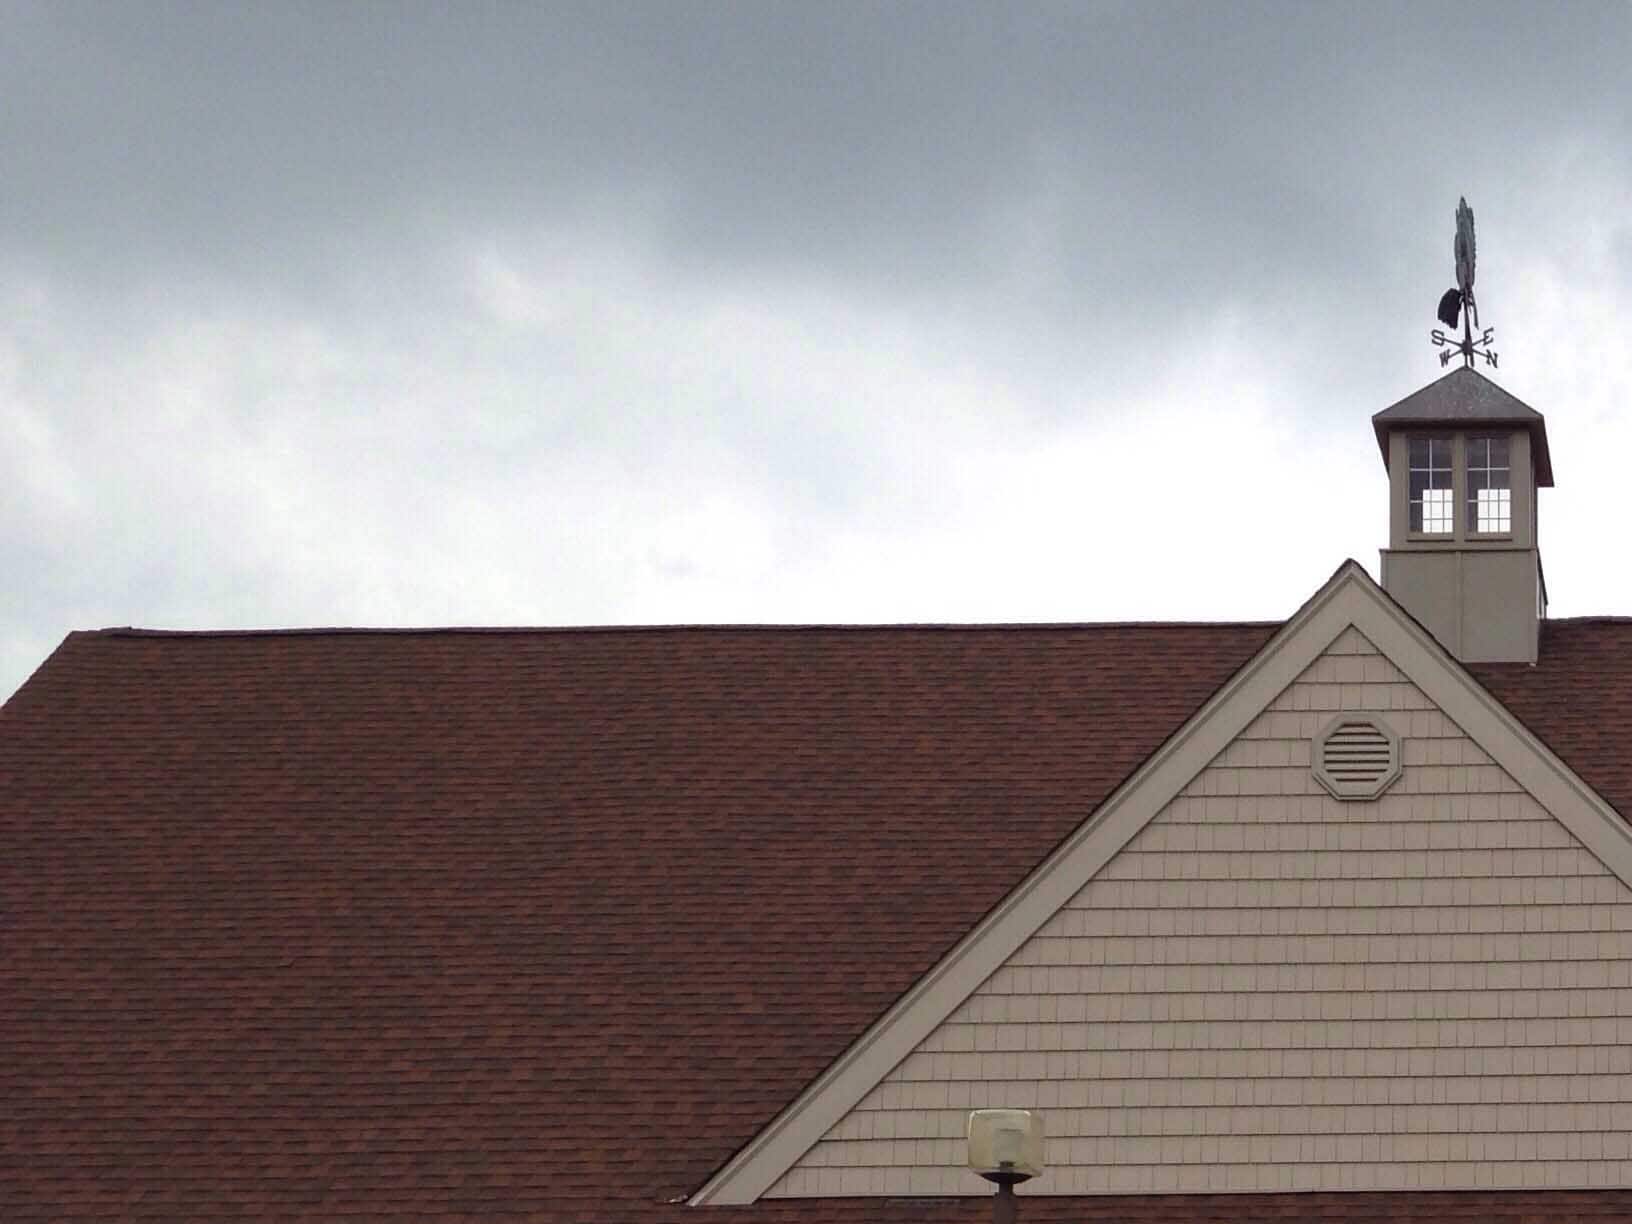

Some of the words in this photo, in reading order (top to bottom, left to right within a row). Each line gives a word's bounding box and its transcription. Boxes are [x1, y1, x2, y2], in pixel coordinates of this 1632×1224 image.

[1431, 329, 1445, 347] S
[1483, 327, 1494, 346] E
[1439, 348, 1450, 368] W
[1486, 349, 1498, 369] N
